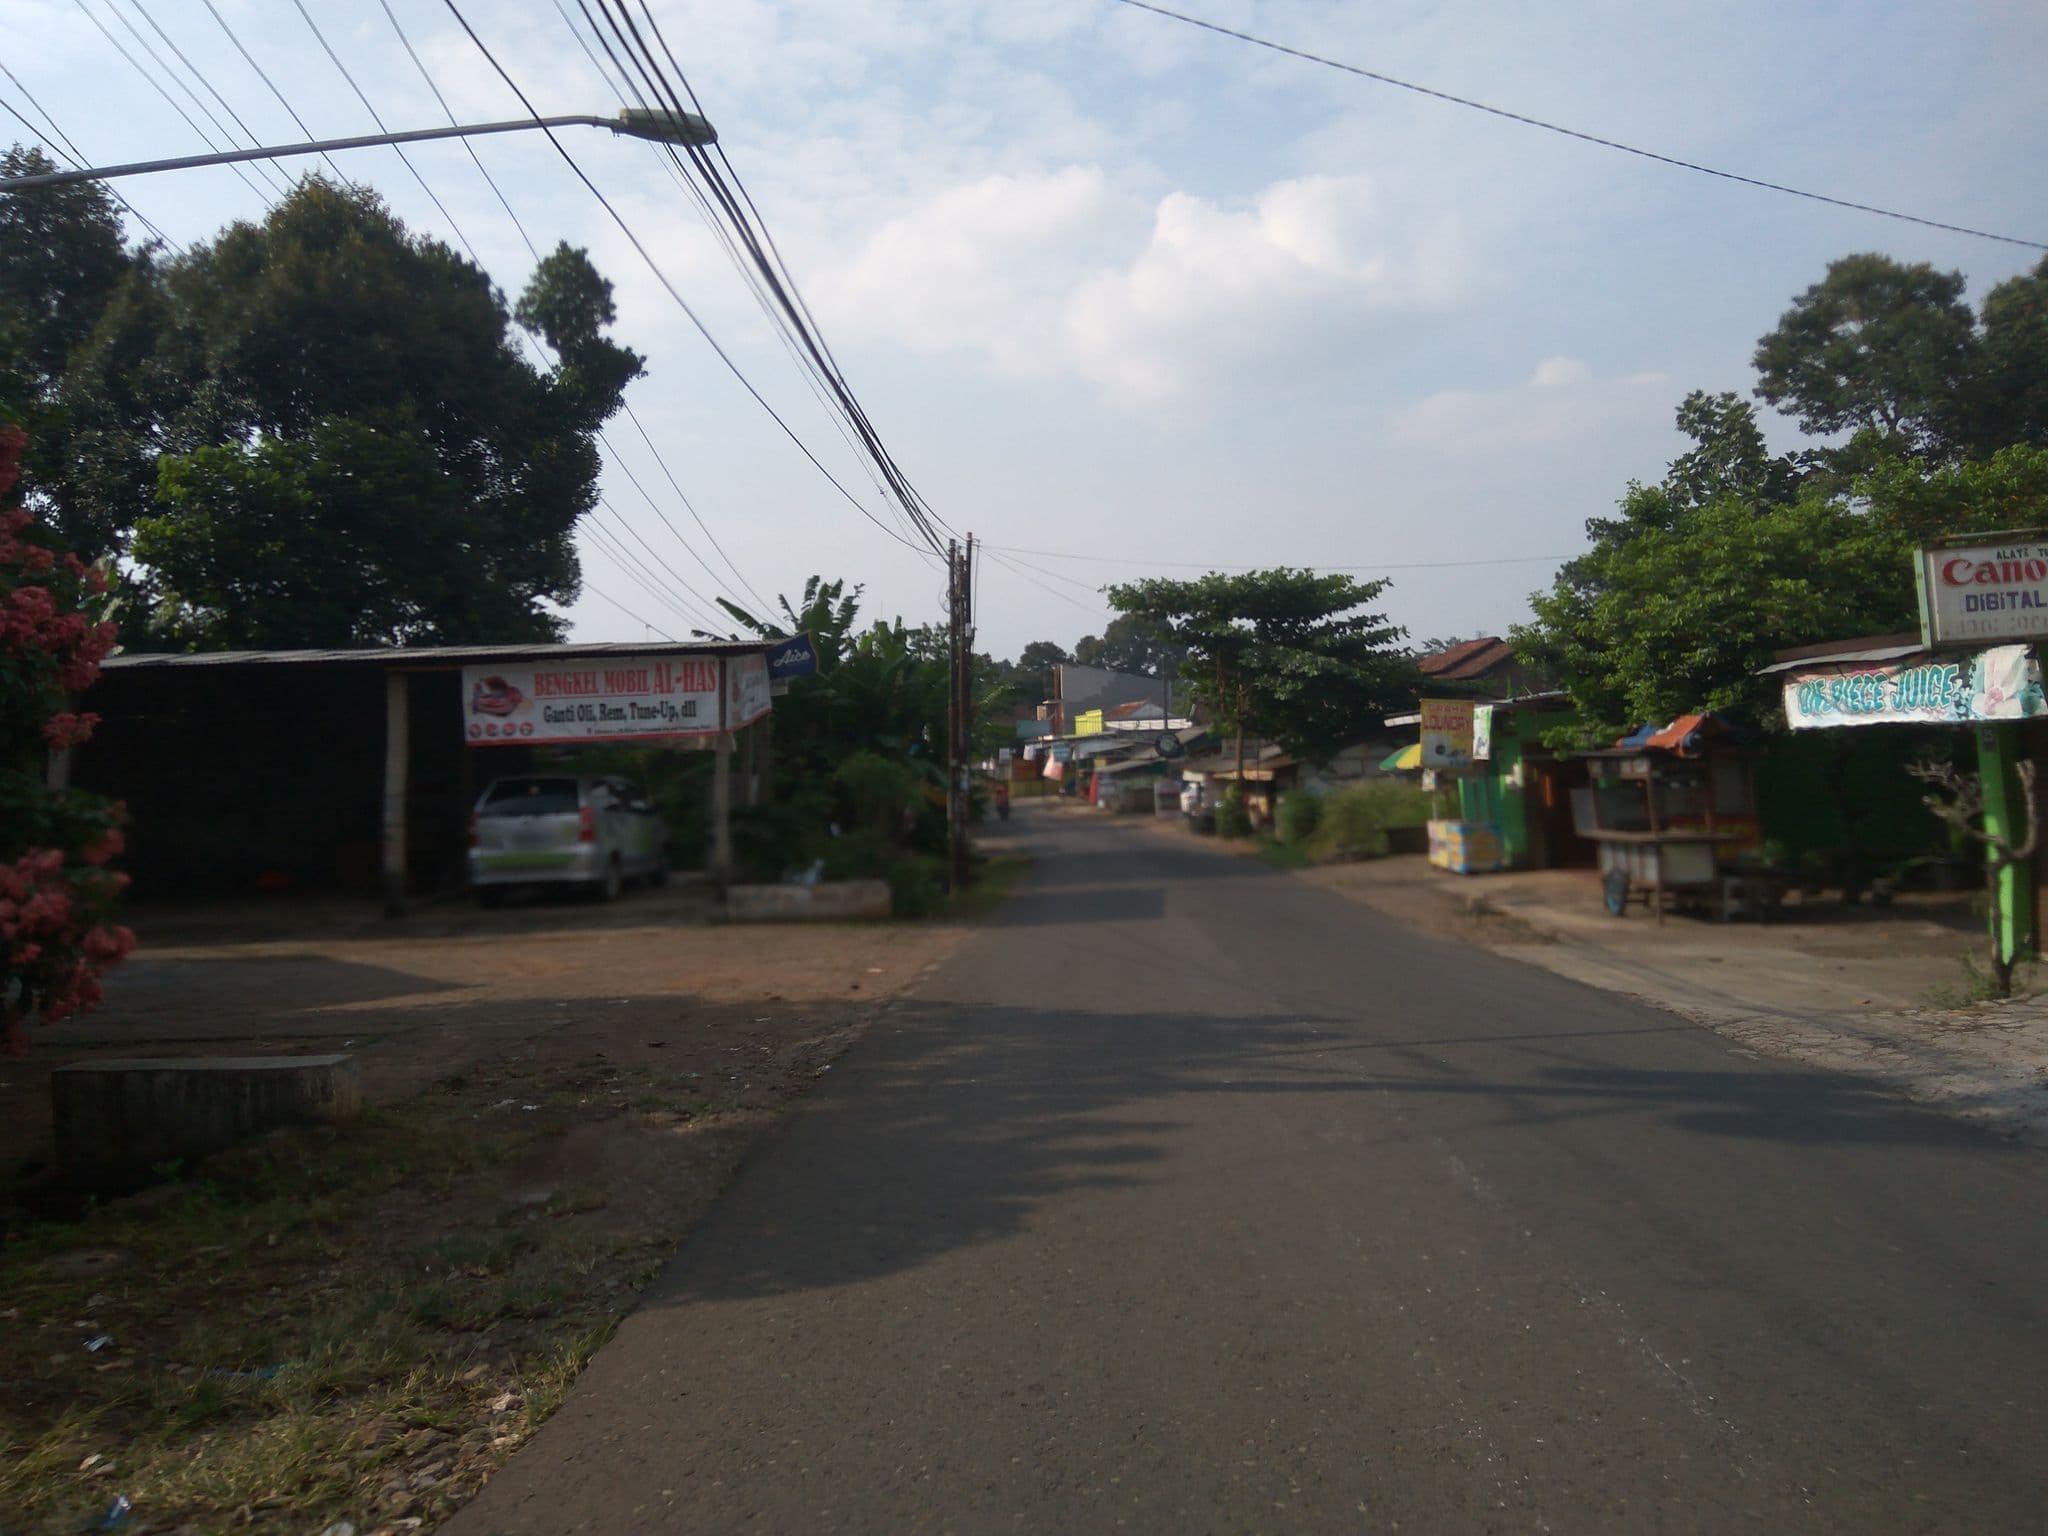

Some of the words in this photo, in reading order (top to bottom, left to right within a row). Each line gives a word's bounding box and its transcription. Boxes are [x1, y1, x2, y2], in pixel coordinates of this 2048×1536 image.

[1942, 558, 2047, 586] Cano
[534, 671, 599, 697] BENGKEL
[604, 669, 649, 694] MOBIL
[653, 661, 716, 694] AL-HAS
[1830, 672, 1889, 713] PIECE
[1891, 664, 1960, 712] JUICE
[543, 704, 575, 723] Ganti
[681, 700, 697, 718] dll
